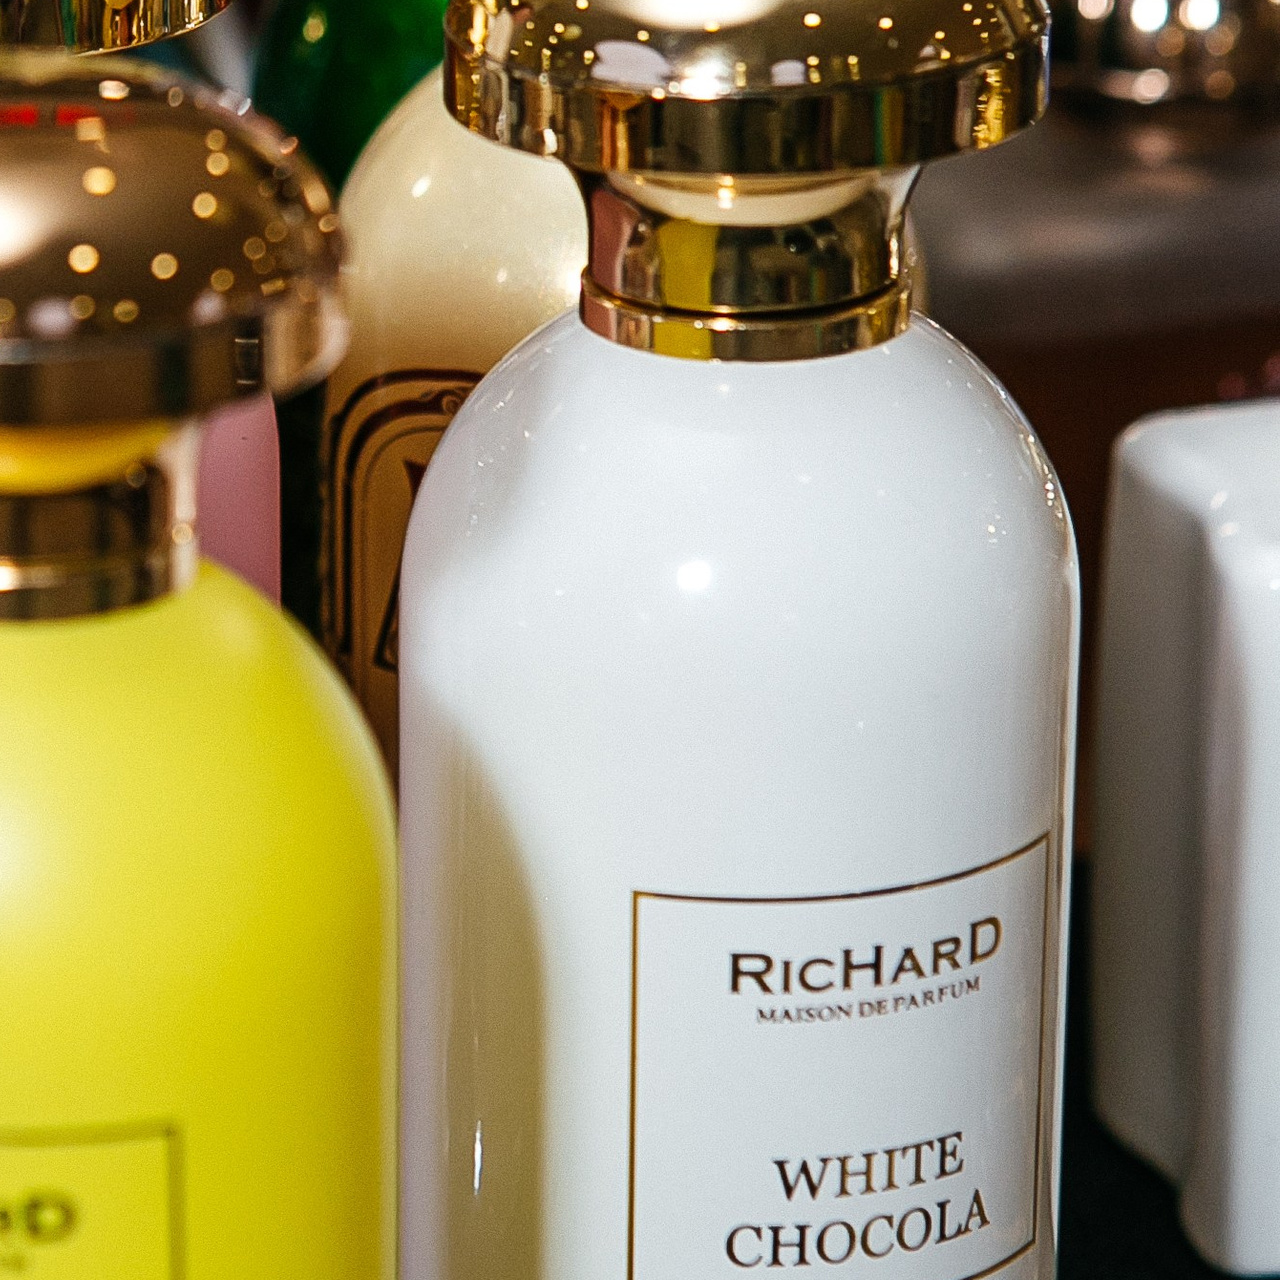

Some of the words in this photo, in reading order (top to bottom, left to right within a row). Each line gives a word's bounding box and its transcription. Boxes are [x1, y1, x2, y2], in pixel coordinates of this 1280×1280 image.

[756, 1001, 853, 1024] MAISON
[859, 998, 889, 1018] DE
[892, 976, 982, 1013] PARFUM
[773, 1130, 966, 1201] WHITE
[724, 1188, 991, 1268] CHOCOLA
